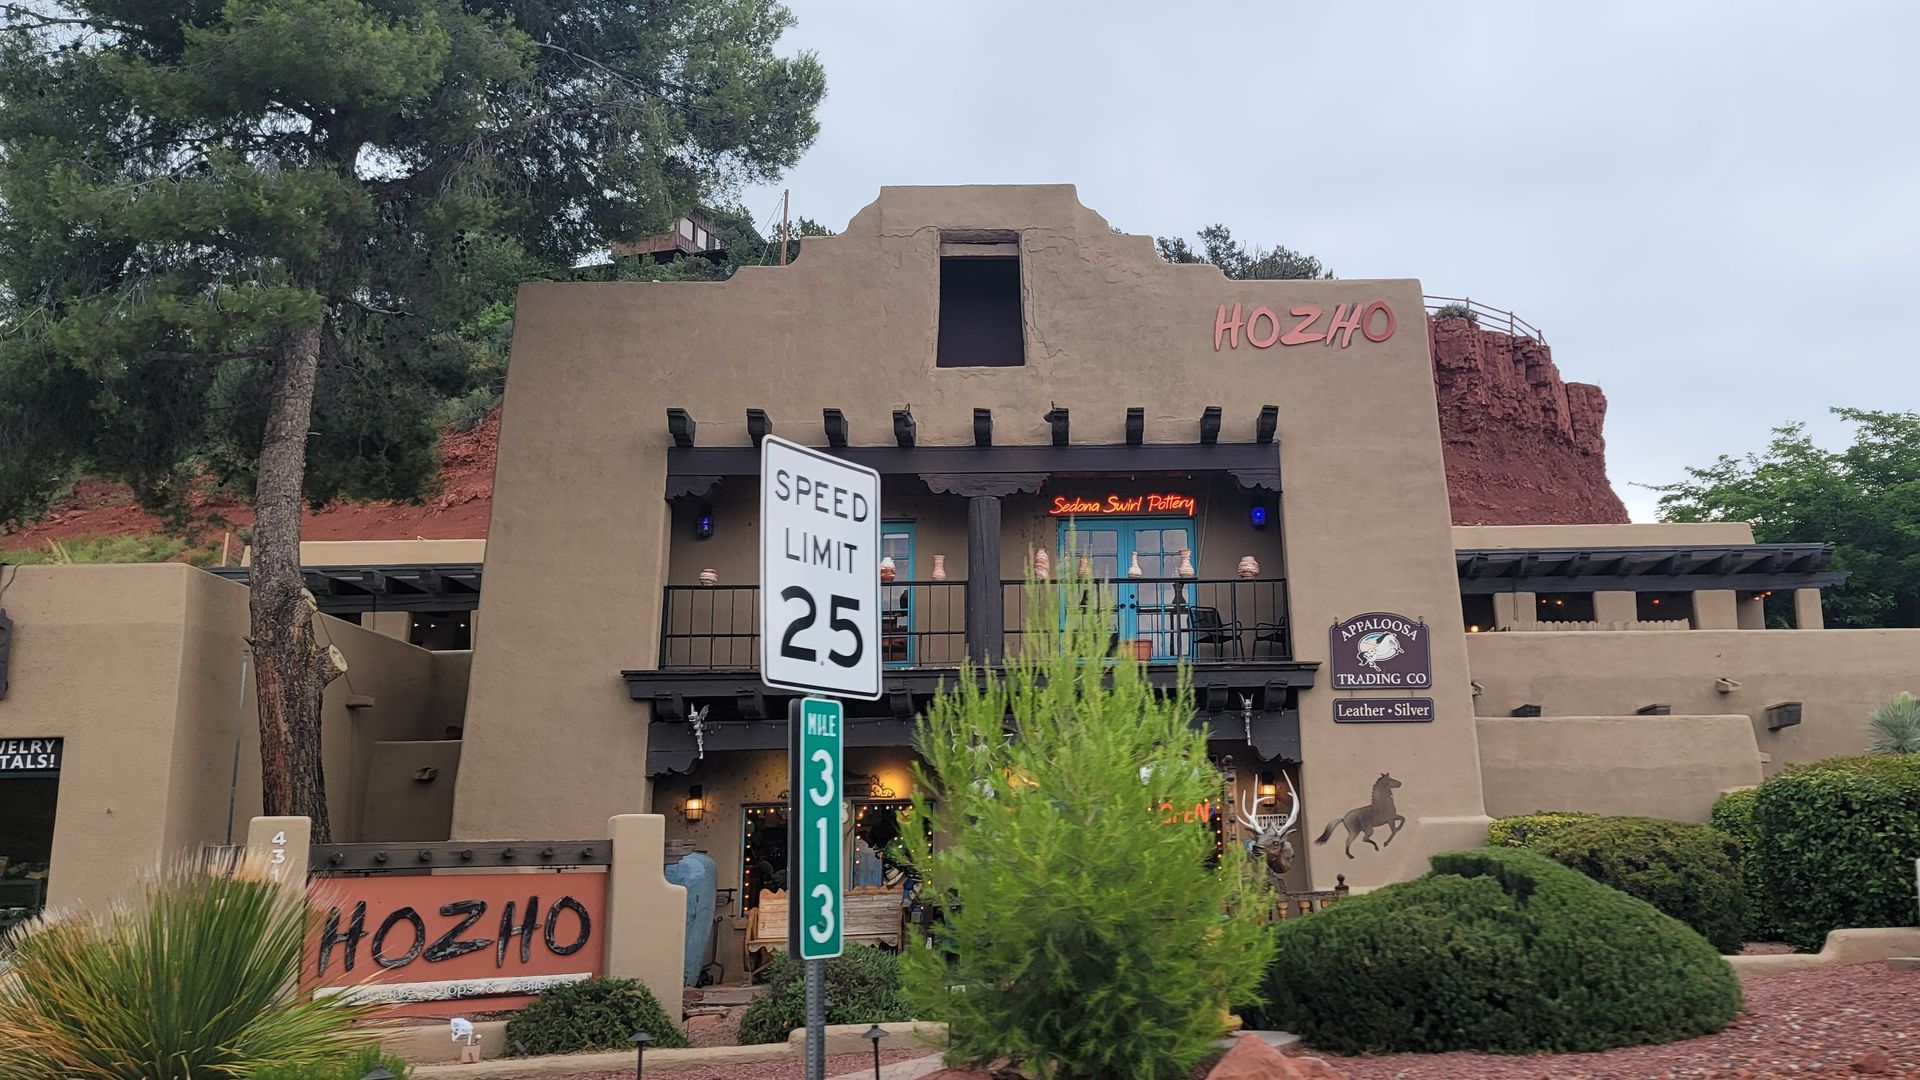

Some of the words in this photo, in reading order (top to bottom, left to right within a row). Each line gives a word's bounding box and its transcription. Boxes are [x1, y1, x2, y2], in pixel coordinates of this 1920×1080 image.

[1214, 301, 1396, 351] HOZHO
[775, 469, 868, 523] SPEED
[1050, 497, 1099, 514] Sedona
[1103, 496, 1142, 513] Swirl
[1147, 494, 1195, 516] Pottery
[785, 527, 858, 574] LIMIT
[780, 585, 863, 668] 25
[1341, 618, 1418, 642] APPALOOSA
[1337, 673, 1401, 685] TRADING
[1406, 673, 1427, 685] CO
[807, 712, 837, 737] MILE
[1338, 703, 1386, 717] Leather
[1394, 703, 1430, 716] Silver
[318, 895, 592, 978] HOZHO
